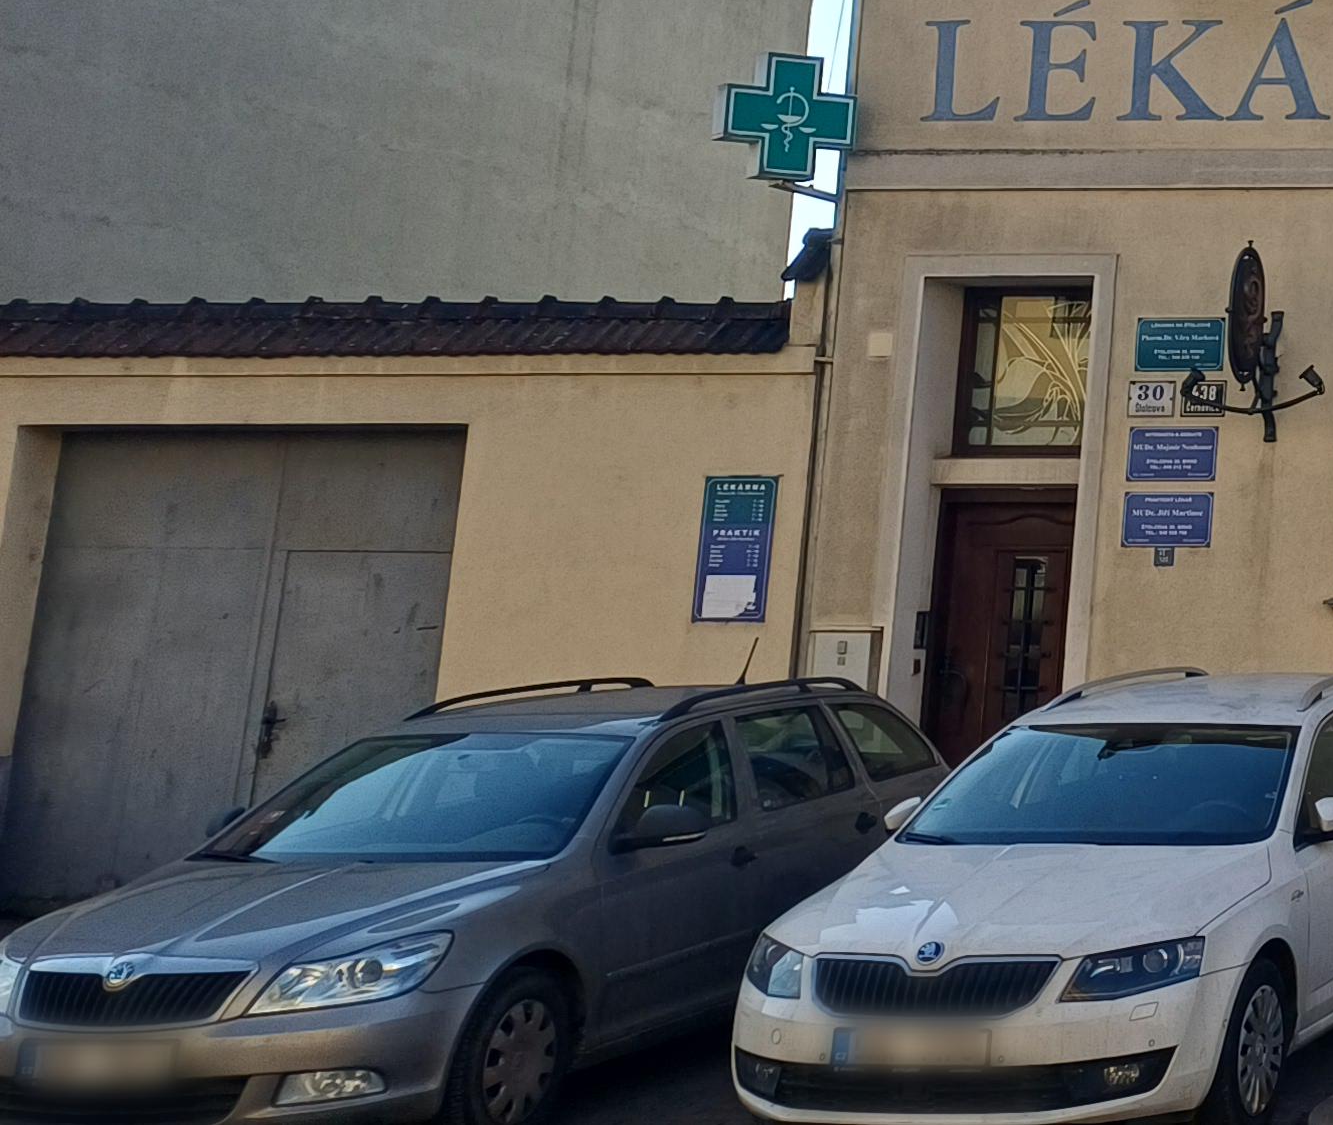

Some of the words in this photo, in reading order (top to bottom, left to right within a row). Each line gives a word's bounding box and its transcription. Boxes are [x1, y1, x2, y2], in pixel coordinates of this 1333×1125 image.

[1137, 384, 1165, 401] 30
[716, 483, 766, 491] LÉKÁRNA
[712, 529, 761, 537] PRAKTIK
